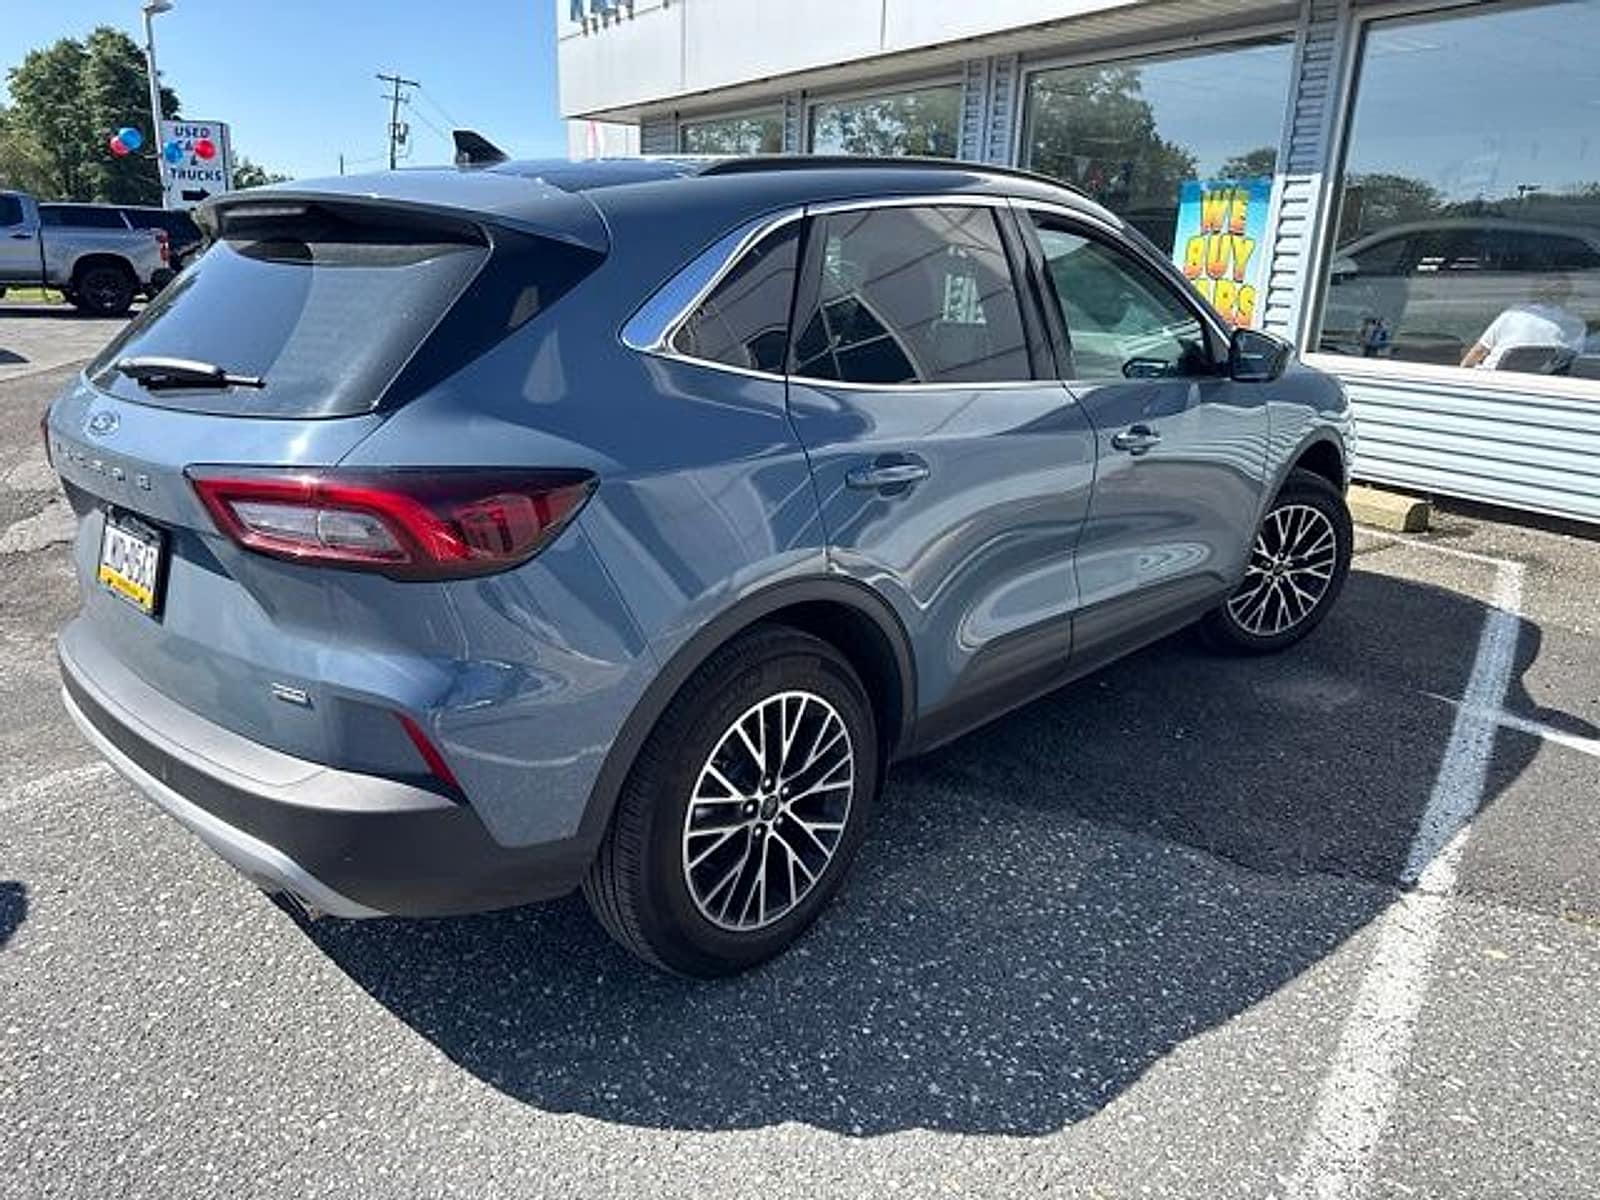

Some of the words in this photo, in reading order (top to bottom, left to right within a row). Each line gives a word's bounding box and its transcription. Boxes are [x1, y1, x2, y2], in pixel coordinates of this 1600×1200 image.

[175, 126, 211, 138] USED
[170, 168, 222, 181] TRUCKS
[1200, 189, 1248, 234] WE
[1184, 234, 1255, 282] BUY
